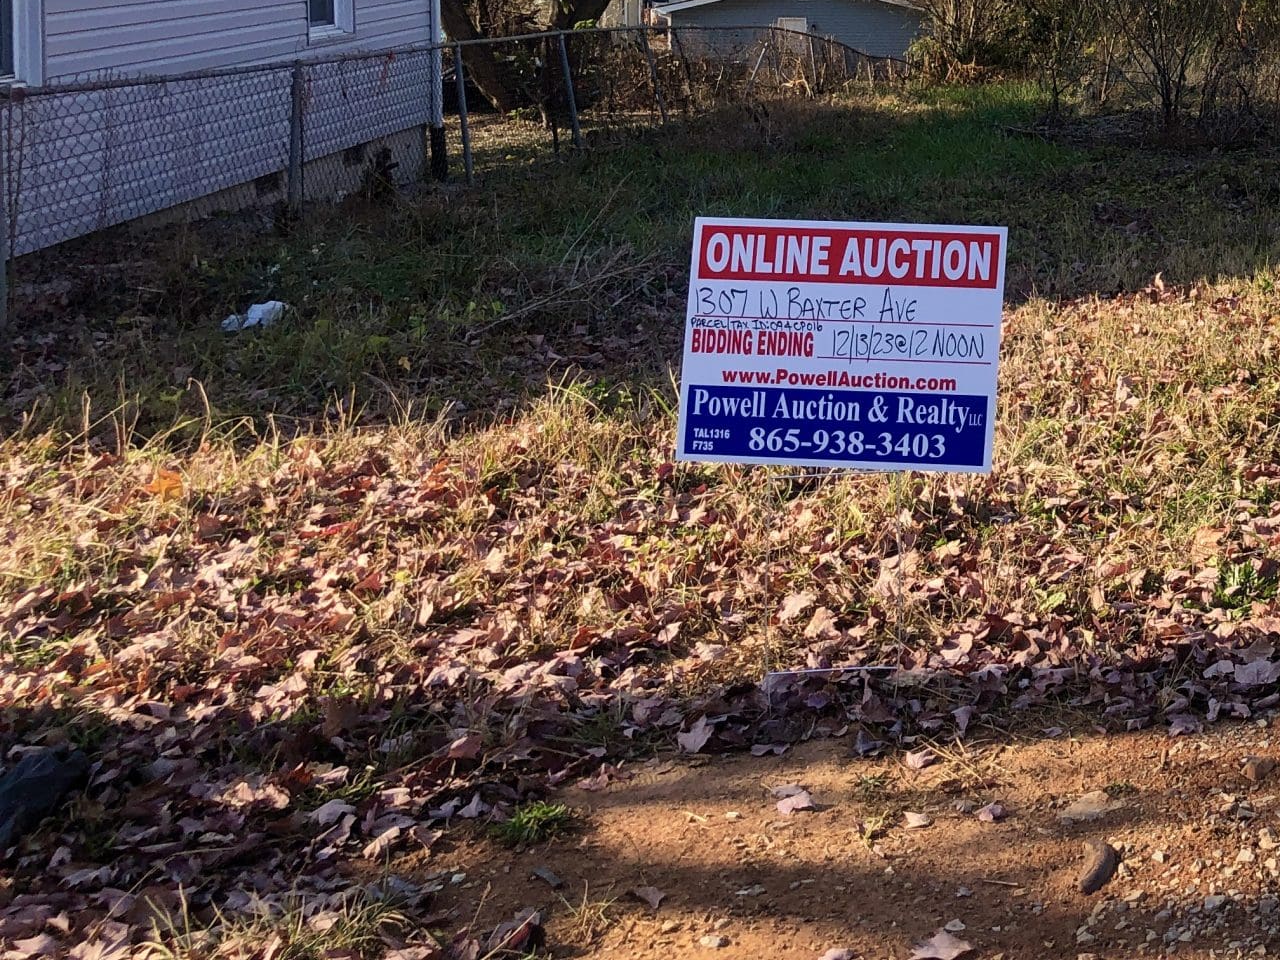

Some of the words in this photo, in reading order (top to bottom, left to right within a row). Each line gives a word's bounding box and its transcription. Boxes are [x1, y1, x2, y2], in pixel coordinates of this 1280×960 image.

[706, 232, 832, 275] ONLINE
[839, 238, 992, 281] AUCTION
[695, 288, 748, 315] 1307
[760, 290, 777, 319] W
[788, 288, 866, 321] BAXTER
[691, 329, 753, 355] BIDDING
[757, 331, 814, 357] ENDING
[932, 328, 984, 359] NOON
[722, 369, 957, 391] www.PowellAuction.com
[692, 389, 766, 418] Powell
[772, 392, 860, 422] Auction
[868, 395, 889, 423] &
[897, 396, 970, 433] Realty
[968, 413, 983, 426] LLC
[692, 441, 714, 451] F735
[693, 428, 730, 439] TAL1316
[749, 427, 946, 458] 865-938-3403
